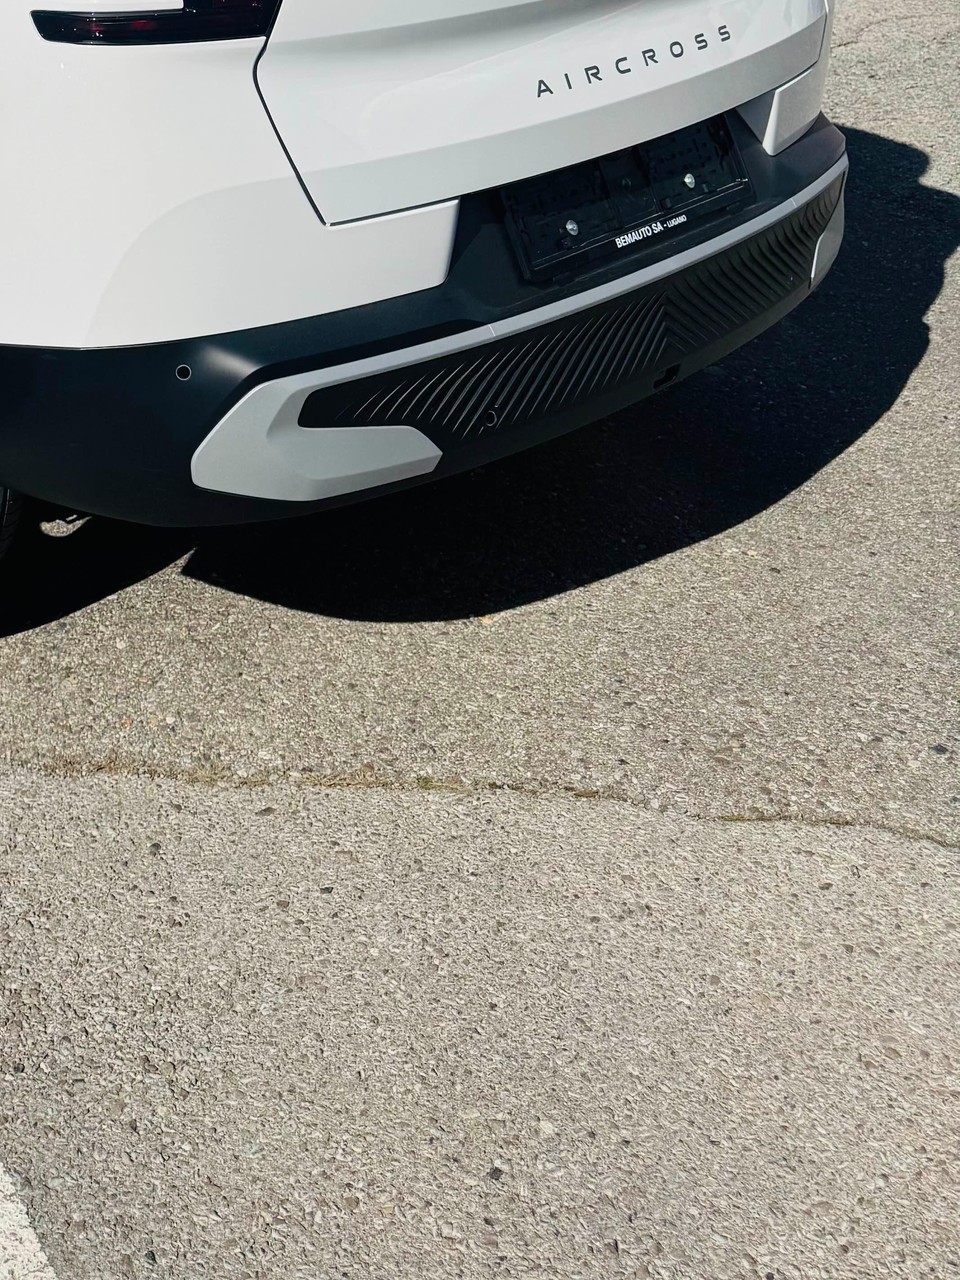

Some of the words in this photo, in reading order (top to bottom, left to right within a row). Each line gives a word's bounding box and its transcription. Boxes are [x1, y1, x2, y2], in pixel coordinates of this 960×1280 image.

[536, 24, 732, 98] AIRCROSS
[615, 225, 653, 249] BEMAUTO
[651, 221, 665, 234] SA
[666, 214, 688, 228] LUGANO
